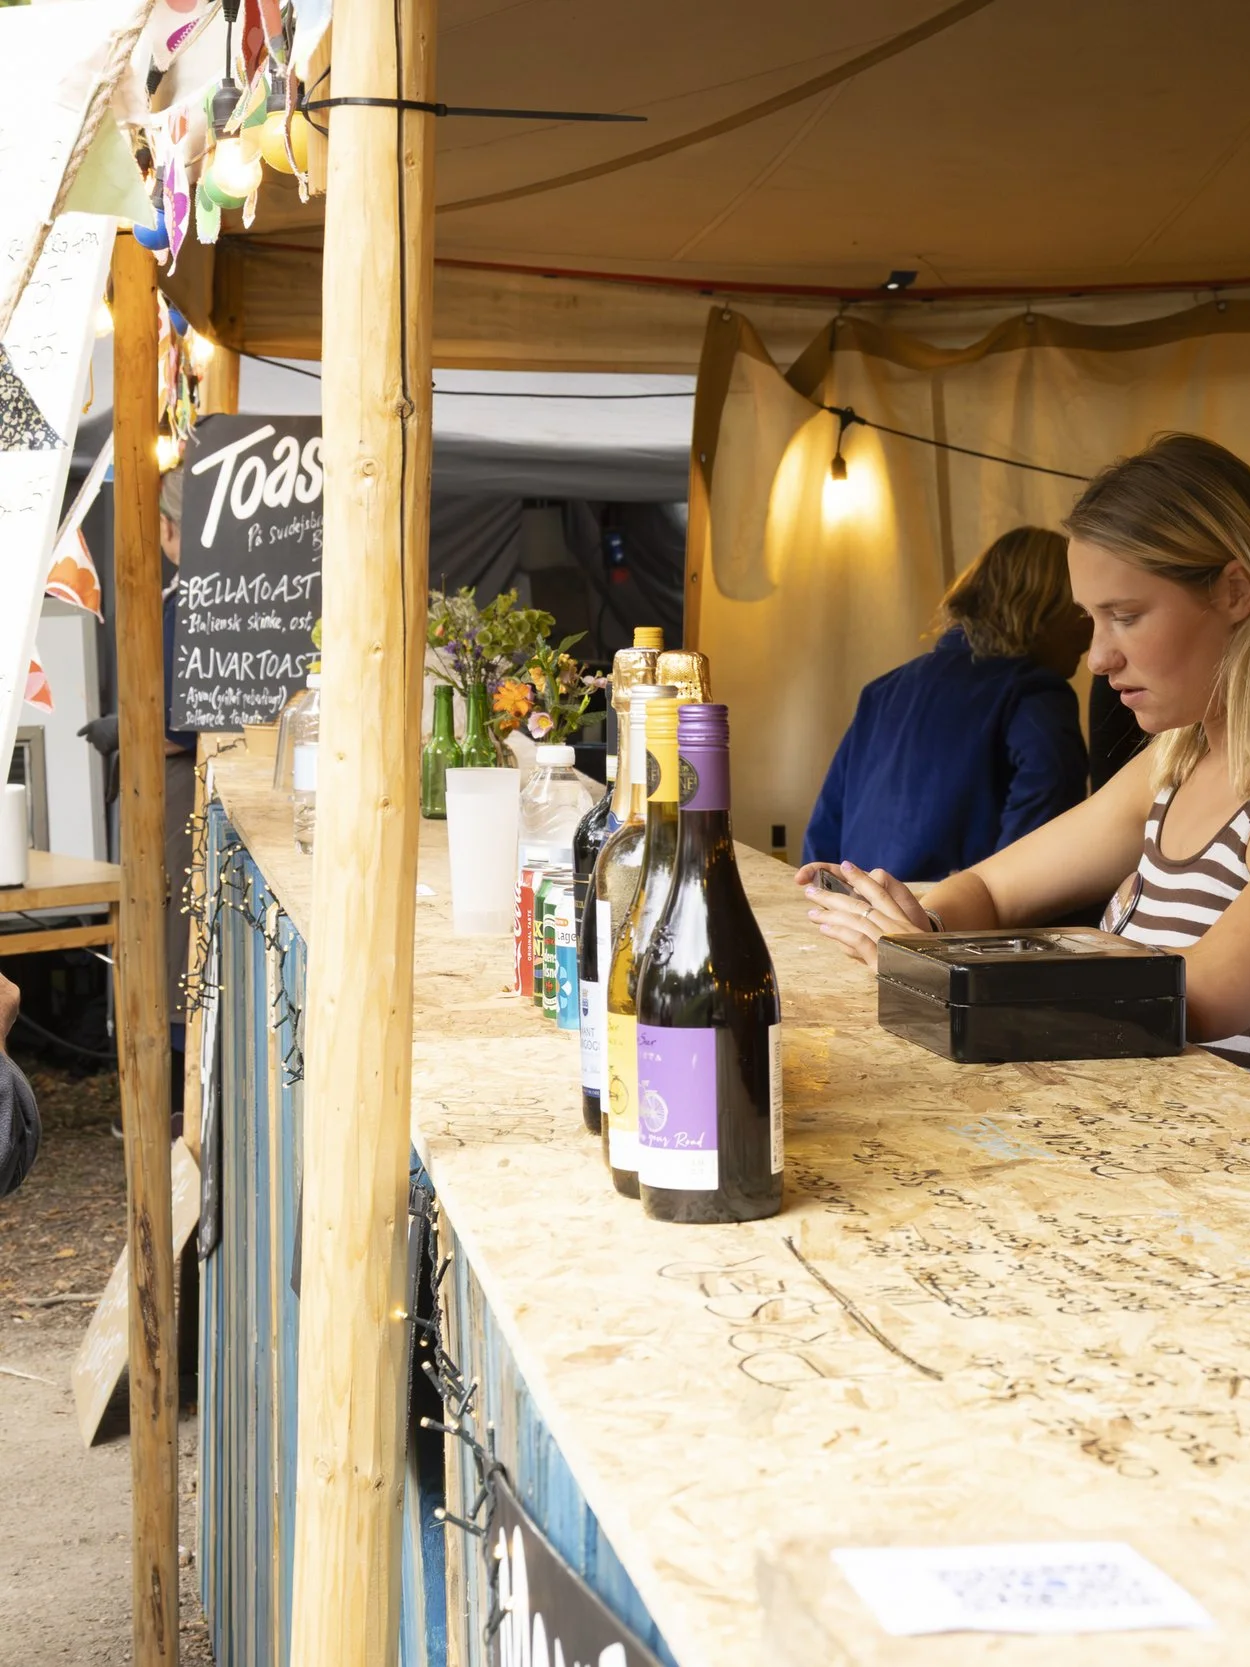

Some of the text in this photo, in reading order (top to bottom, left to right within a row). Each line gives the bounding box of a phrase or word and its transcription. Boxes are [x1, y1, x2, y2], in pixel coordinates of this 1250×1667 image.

[191, 424, 323, 548] Toas
[188, 571, 321, 610] BELLATOAST
[674, 1131, 706, 1148] Road
